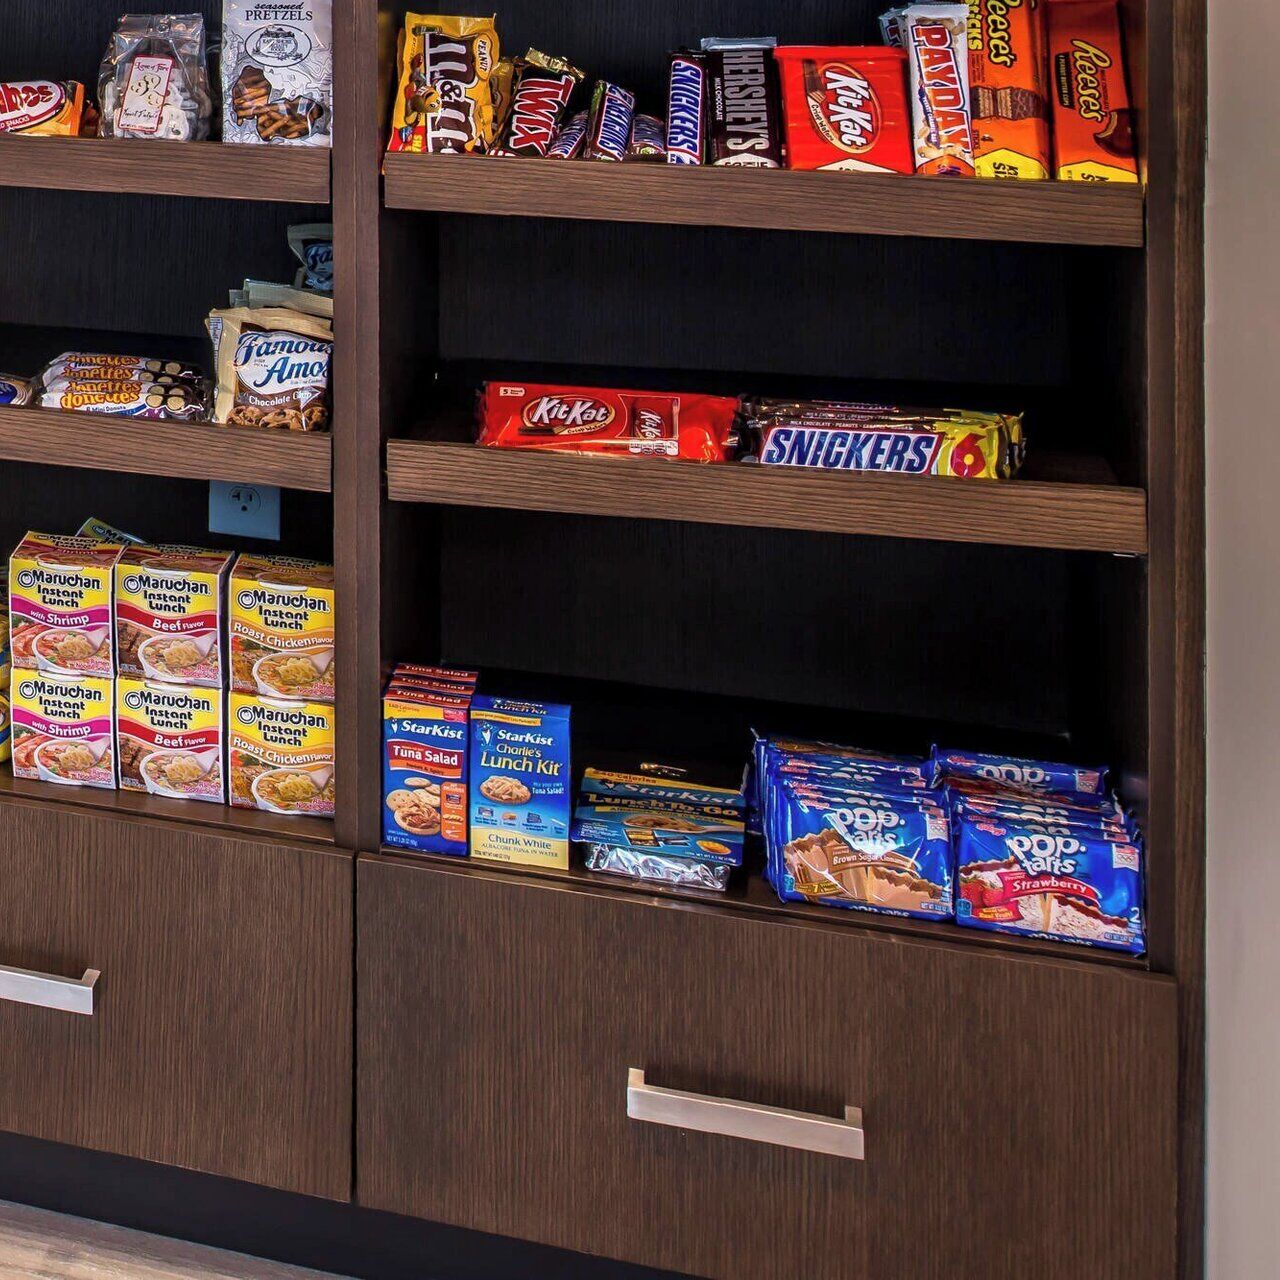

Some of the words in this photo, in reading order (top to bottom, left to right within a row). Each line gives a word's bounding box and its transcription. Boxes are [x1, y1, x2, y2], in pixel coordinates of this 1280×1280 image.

[254, 1, 304, 10] seasoned
[245, 10, 313, 21] PRETZELS
[477, 38, 488, 73] PEANUT
[911, 24, 972, 153] PAYDAY
[1071, 39, 1112, 122] Reese's
[670, 61, 702, 152] SNICKERS
[724, 48, 770, 150] HERSHEY'S
[509, 76, 575, 154] TWIX
[235, 333, 334, 366] Famous
[248, 393, 290, 407] Chocolate
[764, 430, 937, 472] SNICKERS
[951, 434, 986, 478] 6
[34, 570, 102, 589] Maruchan
[139, 576, 210, 595] Maruchan
[38, 586, 83, 599] Instant
[144, 590, 190, 604] Instant
[254, 590, 328, 611] Maruchan
[42, 597, 79, 608] Lunch
[149, 602, 185, 613] Lunch
[30, 610, 45, 620] with
[47, 613, 89, 626] Shrimp
[259, 606, 308, 620] Instant
[153, 618, 181, 630] Beef
[264, 618, 303, 630] Lunch
[234, 623, 265, 641] Roast
[267, 635, 311, 648] Chicken
[34, 681, 102, 701] Maruchan
[39, 697, 85, 710] Instant
[141, 693, 211, 711] Maruchan
[44, 708, 80, 719] Lunch
[145, 707, 192, 720] Instant
[253, 706, 327, 728] Maruchan
[32, 721, 47, 731] with
[49, 723, 90, 737] Shrimp
[151, 718, 187, 730] Lunch
[258, 722, 308, 737] Instant
[401, 720, 463, 740] StarKist
[155, 734, 183, 746] Beef
[263, 735, 302, 746] Lunch
[497, 730, 552, 745] StarKist
[234, 739, 264, 757] Roast
[266, 751, 310, 764] Chicken
[394, 746, 422, 760] Tuna
[426, 752, 458, 766] Salad
[496, 744, 541, 758] Charlie's
[481, 752, 533, 773] Lunch
[537, 759, 561, 776] Kit
[489, 834, 517, 846] Chunk
[520, 838, 551, 849] White
[1022, 857, 1076, 875] tarts
[1013, 878, 1087, 893] Strawberry
